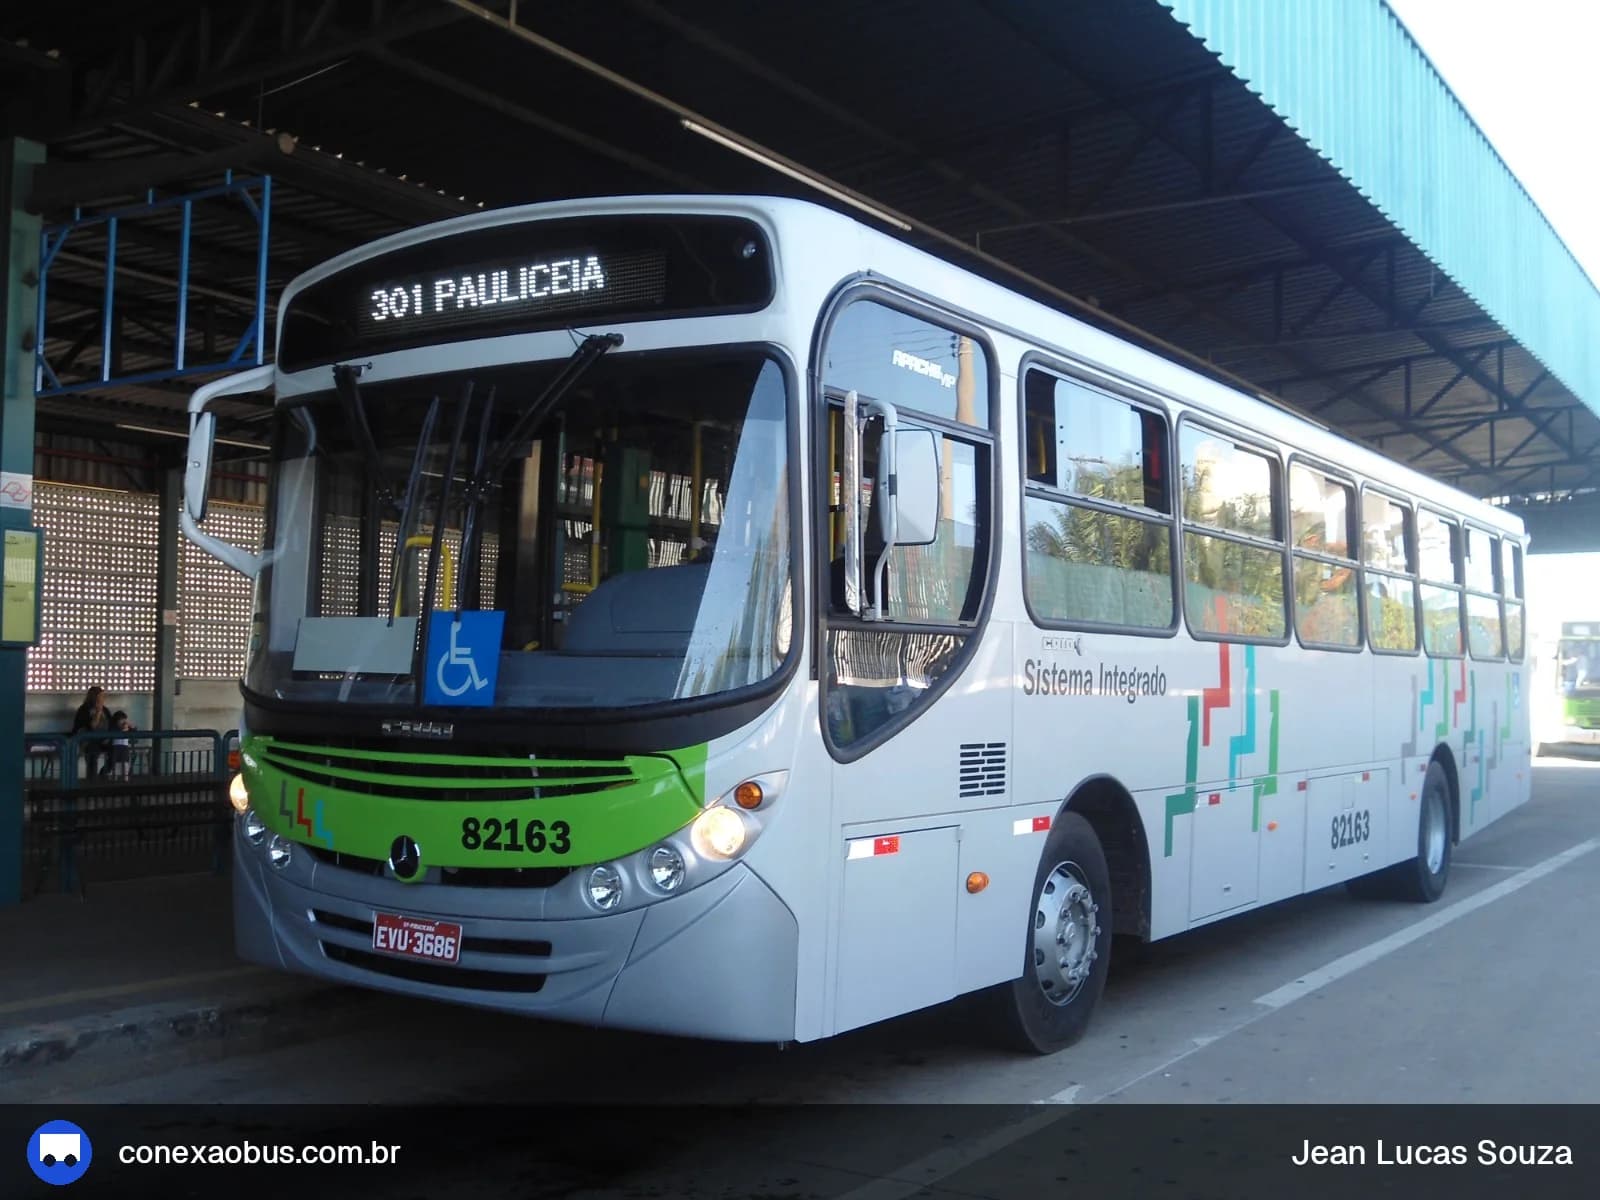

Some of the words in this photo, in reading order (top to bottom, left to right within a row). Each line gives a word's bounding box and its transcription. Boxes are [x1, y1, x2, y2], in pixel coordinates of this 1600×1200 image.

[371, 284, 422, 320] 301
[434, 256, 605, 312] PAULICEIA
[1023, 658, 1093, 696] Sistema
[1099, 662, 1167, 704] Integrado
[461, 816, 571, 855] 82163
[1331, 809, 1370, 850] 82163
